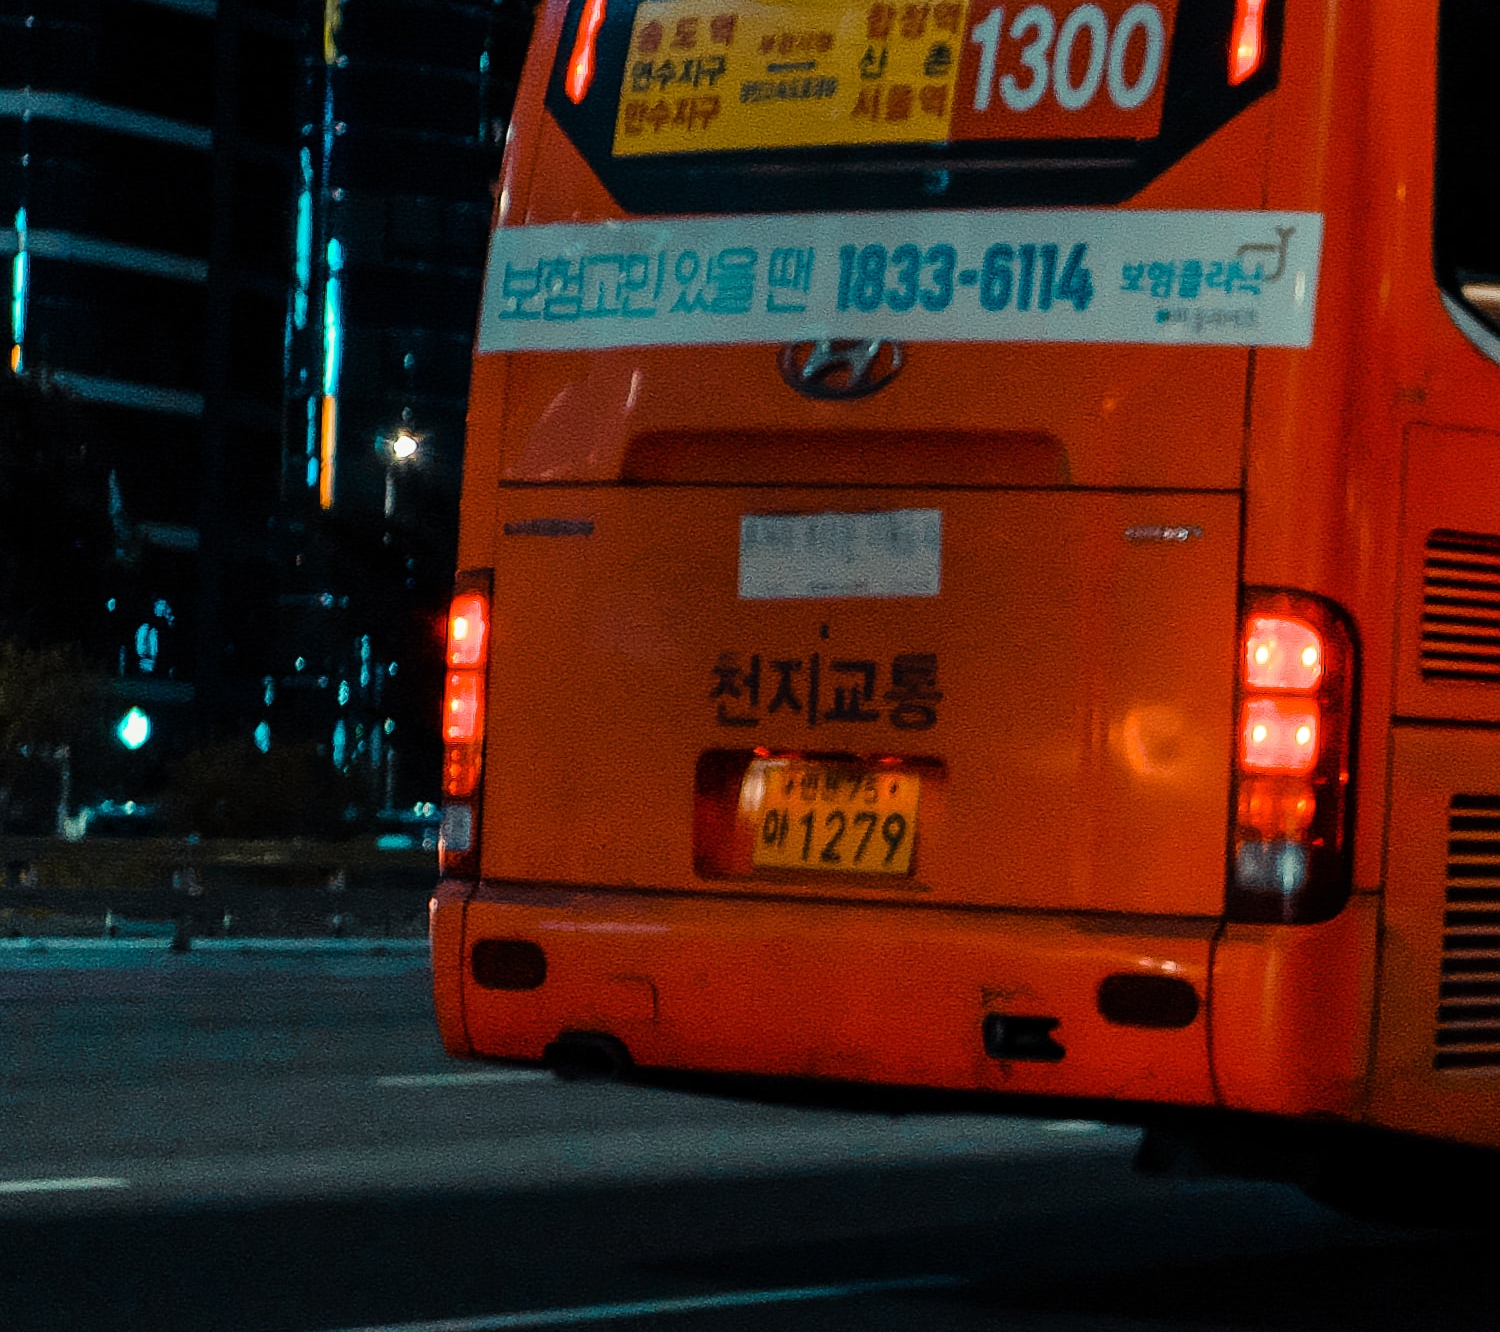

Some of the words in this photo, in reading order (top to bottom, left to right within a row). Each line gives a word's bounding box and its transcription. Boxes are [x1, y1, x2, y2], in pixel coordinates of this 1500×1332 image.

[972, 2, 1163, 111] 1300
[498, 252, 666, 321] 보험고민
[668, 247, 758, 314] 있을
[836, 242, 1096, 313] 1833-6114
[709, 652, 944, 730] 천지교통
